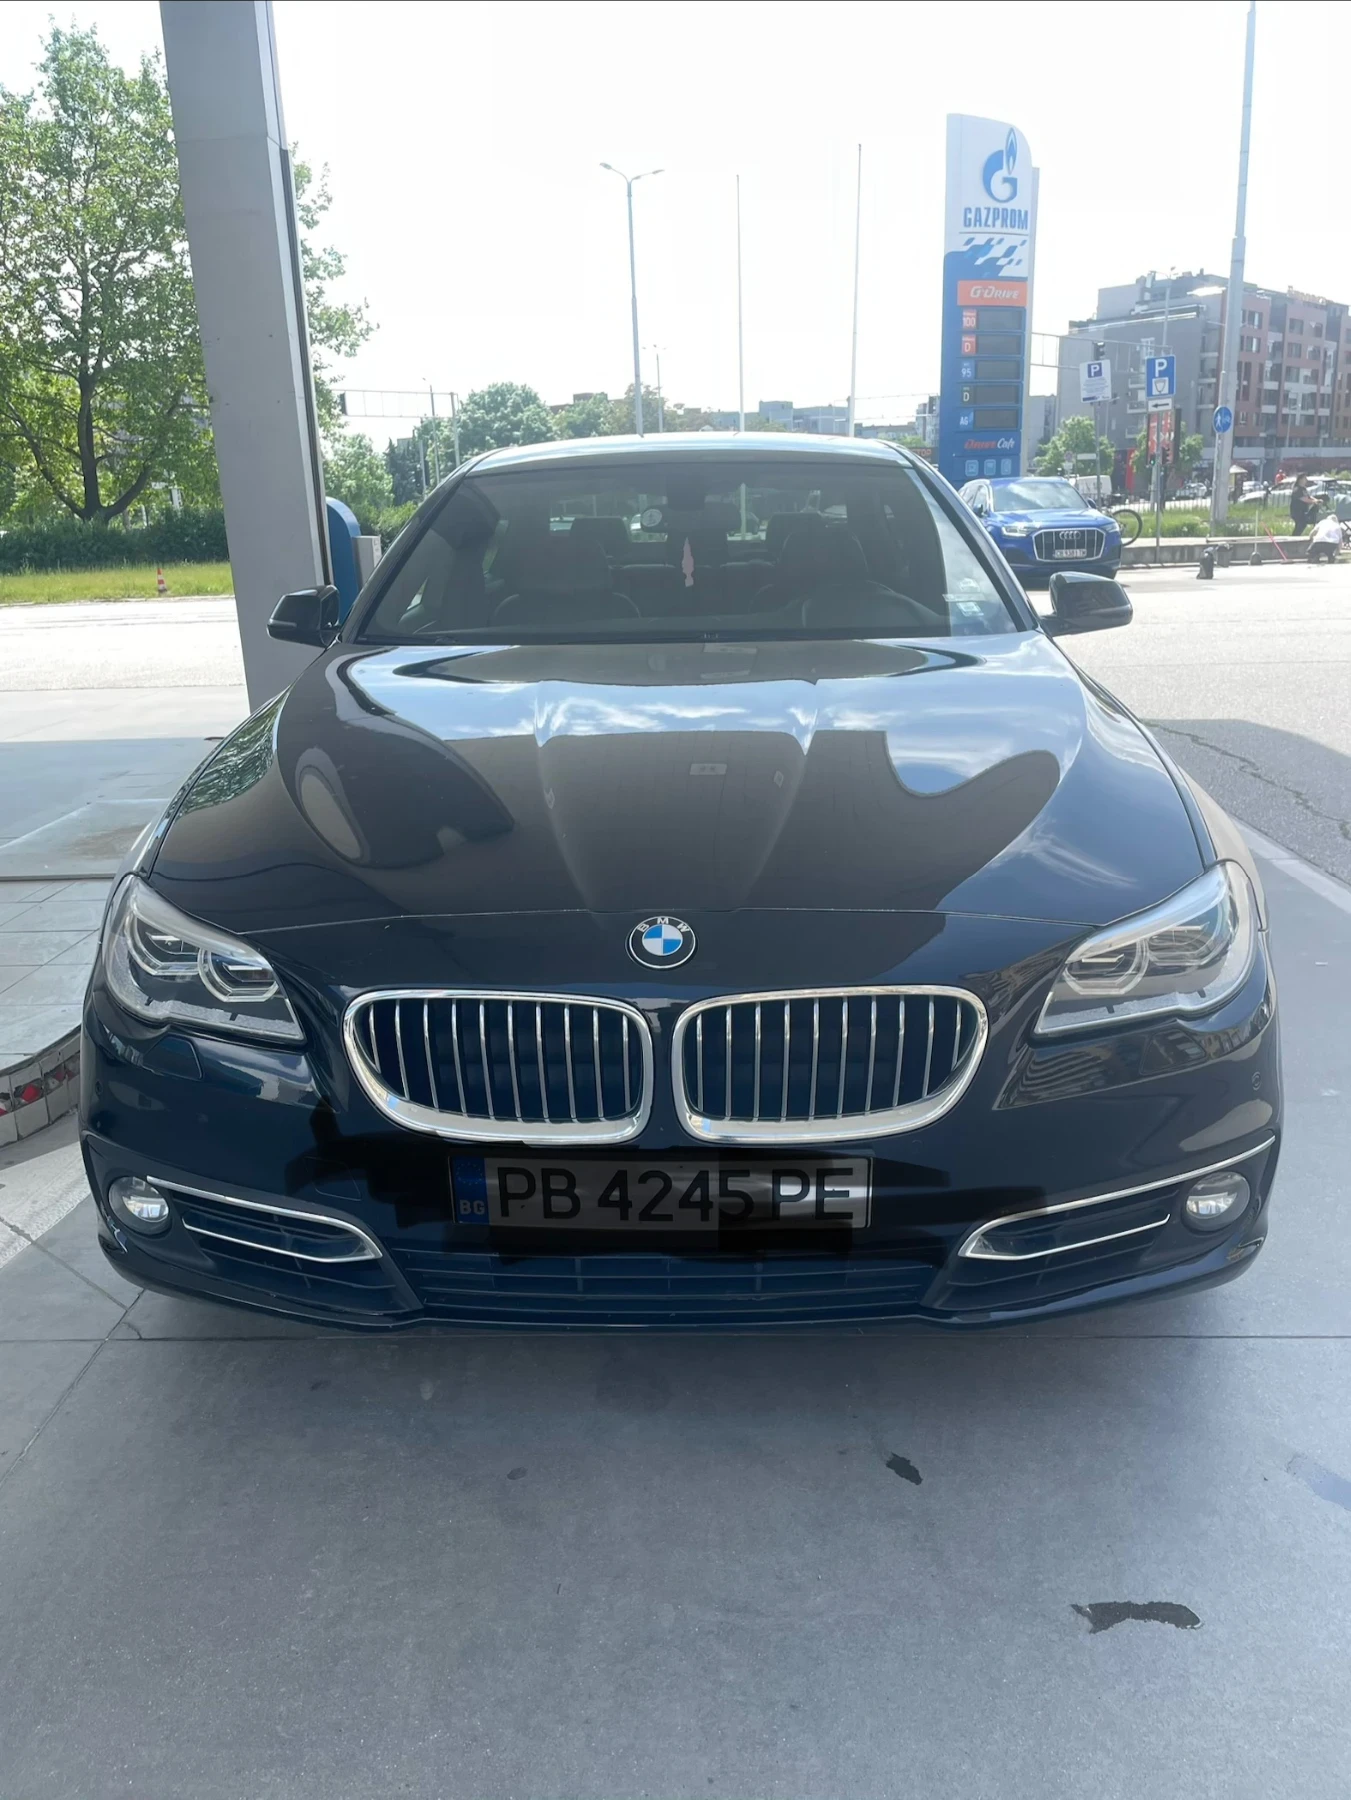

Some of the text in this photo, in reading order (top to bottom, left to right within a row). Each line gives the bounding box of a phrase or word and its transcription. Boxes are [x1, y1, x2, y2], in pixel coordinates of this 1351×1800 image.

[963, 207, 1028, 230] GAZPROM
[963, 316, 976, 328] 100
[964, 342, 972, 353] D
[961, 368, 972, 378] 95
[1090, 364, 1100, 377] P
[1154, 358, 1168, 377] P
[963, 391, 970, 402] D
[637, 917, 691, 933] BMW
[497, 1166, 854, 1222] PB 4245 PE
[459, 1200, 486, 1216] BG
